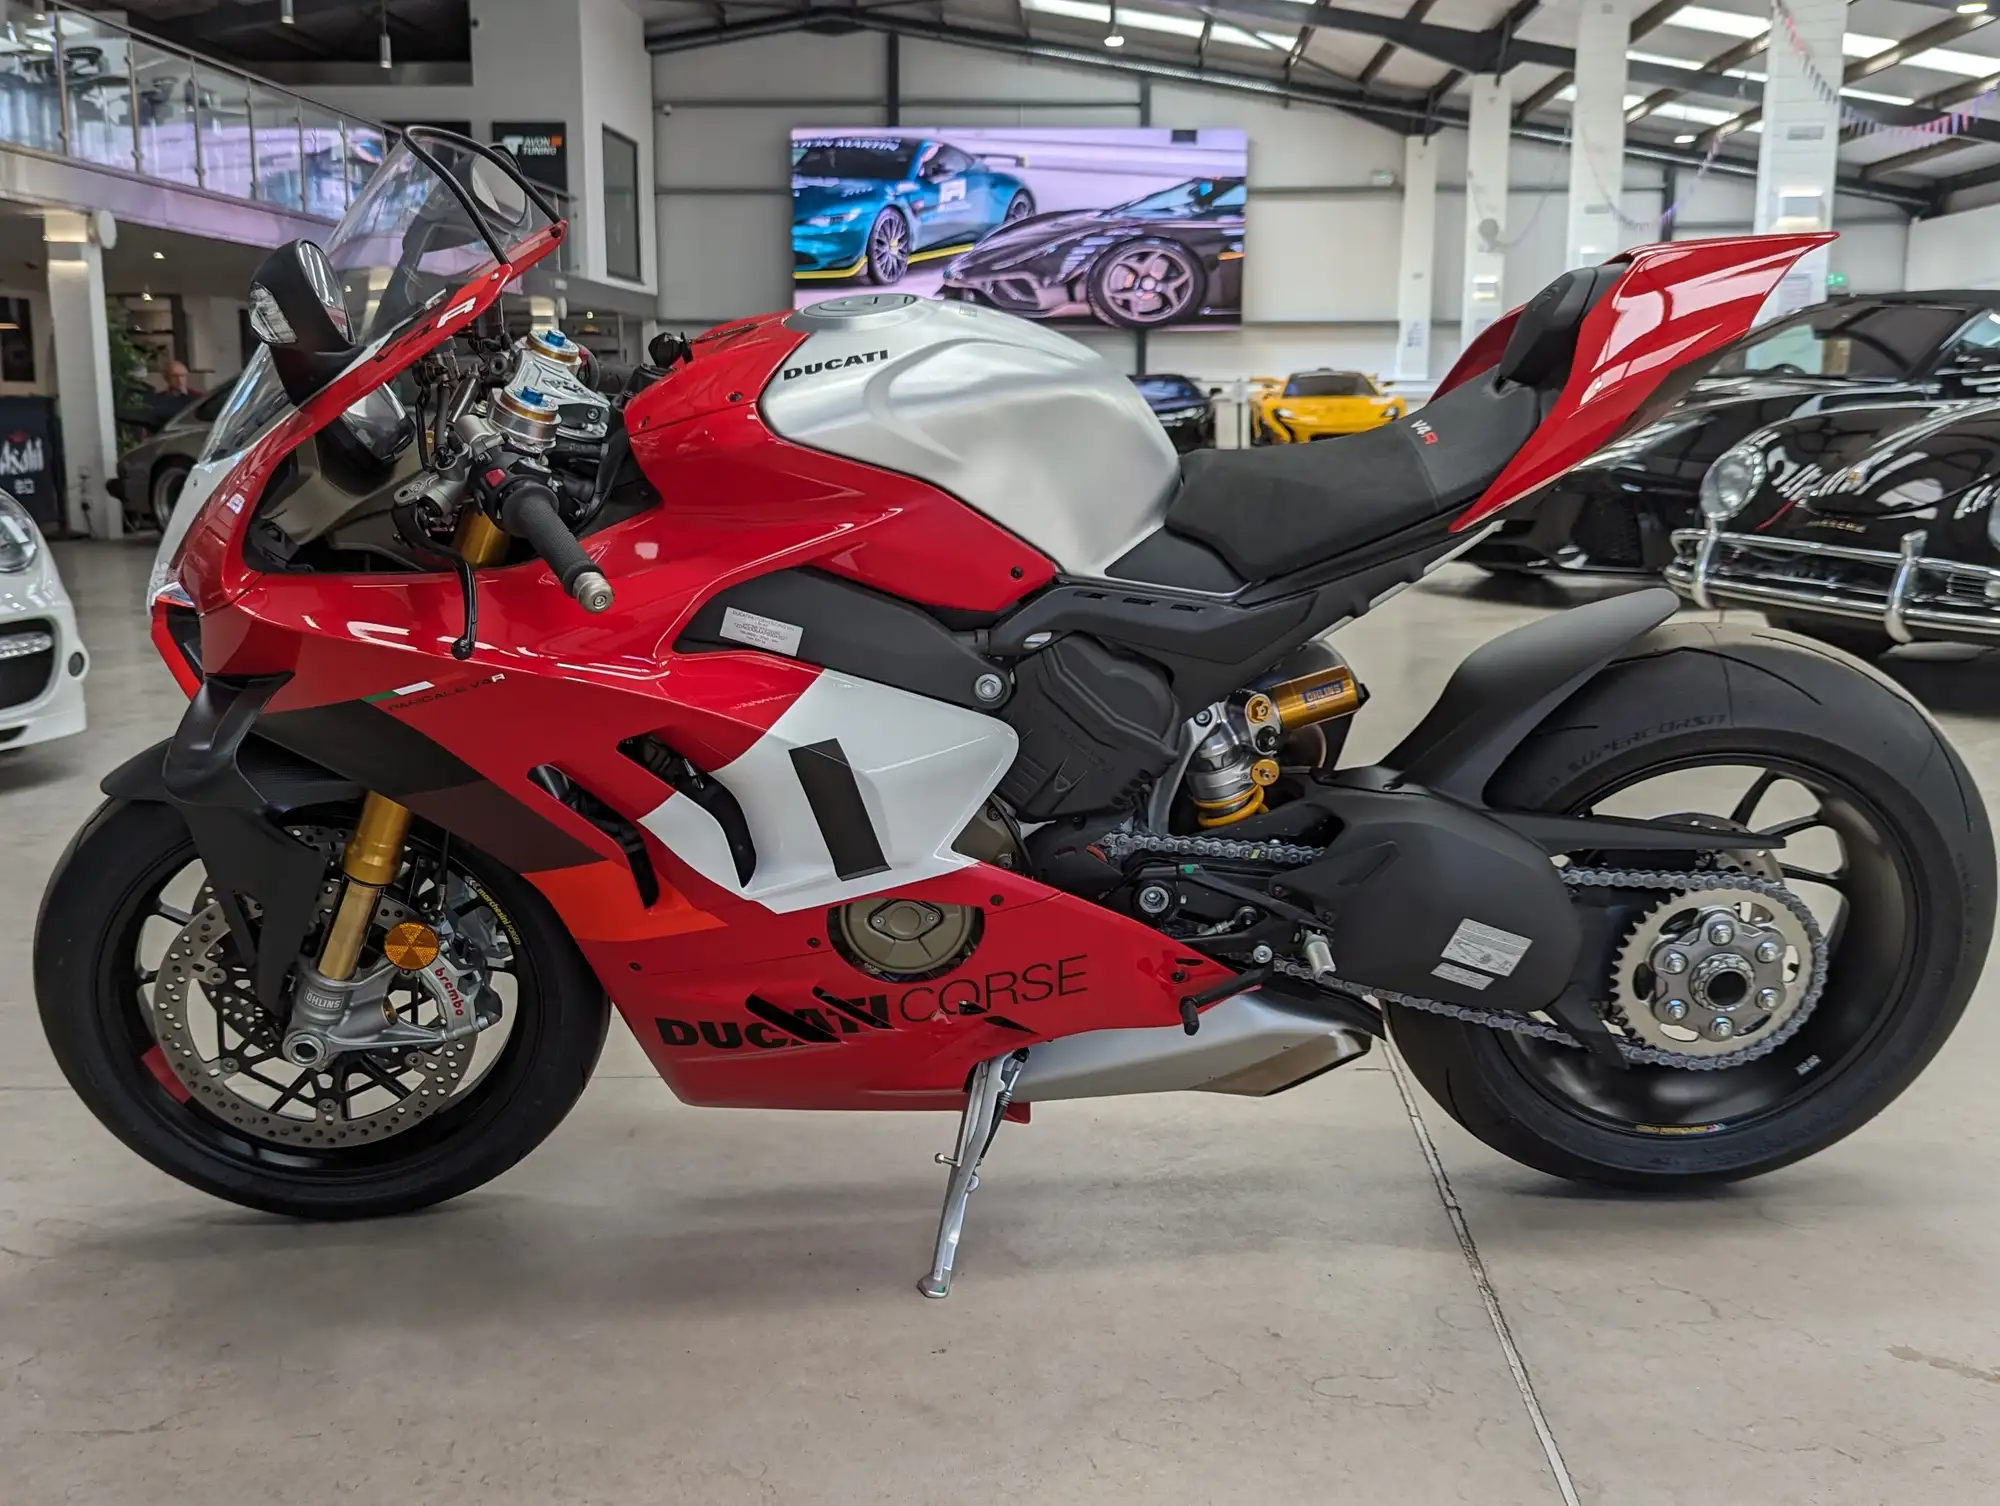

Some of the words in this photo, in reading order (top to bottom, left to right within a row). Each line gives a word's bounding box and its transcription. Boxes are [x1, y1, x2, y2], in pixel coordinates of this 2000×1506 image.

[523, 147, 557, 156] TUNING
[524, 136, 551, 147] AVON
[783, 349, 888, 381] DUCATI
[1410, 419, 1438, 445] V4R
[434, 966, 464, 1016] brembo
[900, 953, 1089, 1023] CORSE
